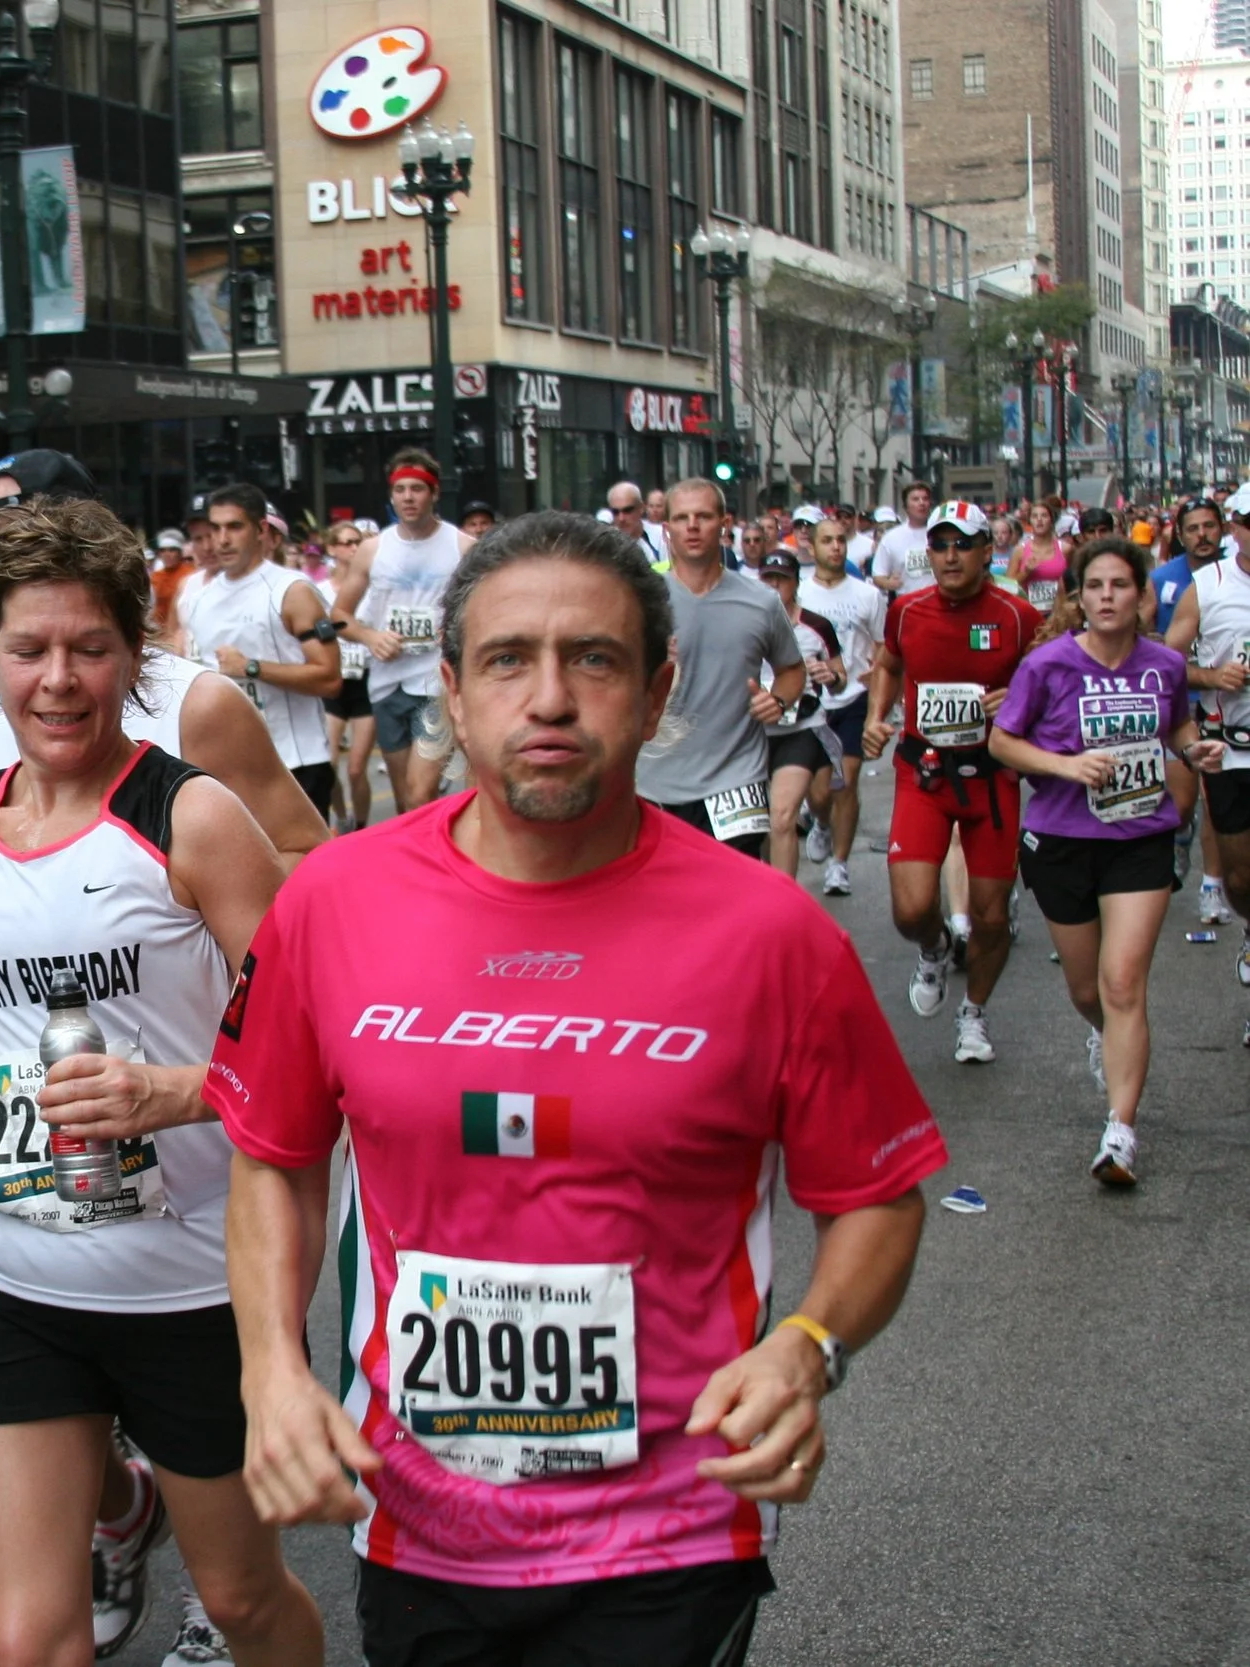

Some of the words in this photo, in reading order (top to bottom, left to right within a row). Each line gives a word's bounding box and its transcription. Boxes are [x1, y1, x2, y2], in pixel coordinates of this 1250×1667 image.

[308, 174, 459, 223] BLIC
[360, 240, 411, 276] art
[312, 278, 462, 320] materias
[517, 371, 561, 411] ZALES
[647, 391, 683, 433] BLICK
[521, 408, 538, 481] ZALES
[921, 699, 981, 723] 22070
[1084, 713, 1157, 738] TEAM
[1097, 758, 1159, 795] 4241
[476, 958, 581, 980] XCEED
[350, 1003, 709, 1063] ALBERTO
[19, 1085, 37, 1095] ABN
[4, 1177, 33, 1197] 30th
[42, 1210, 61, 1220] 2007
[457, 1278, 532, 1303] LaSalle
[538, 1283, 592, 1304] Bank
[400, 1312, 618, 1408] 20995
[432, 1412, 469, 1433] 30th
[475, 1408, 620, 1433] ANNIVERSARY
